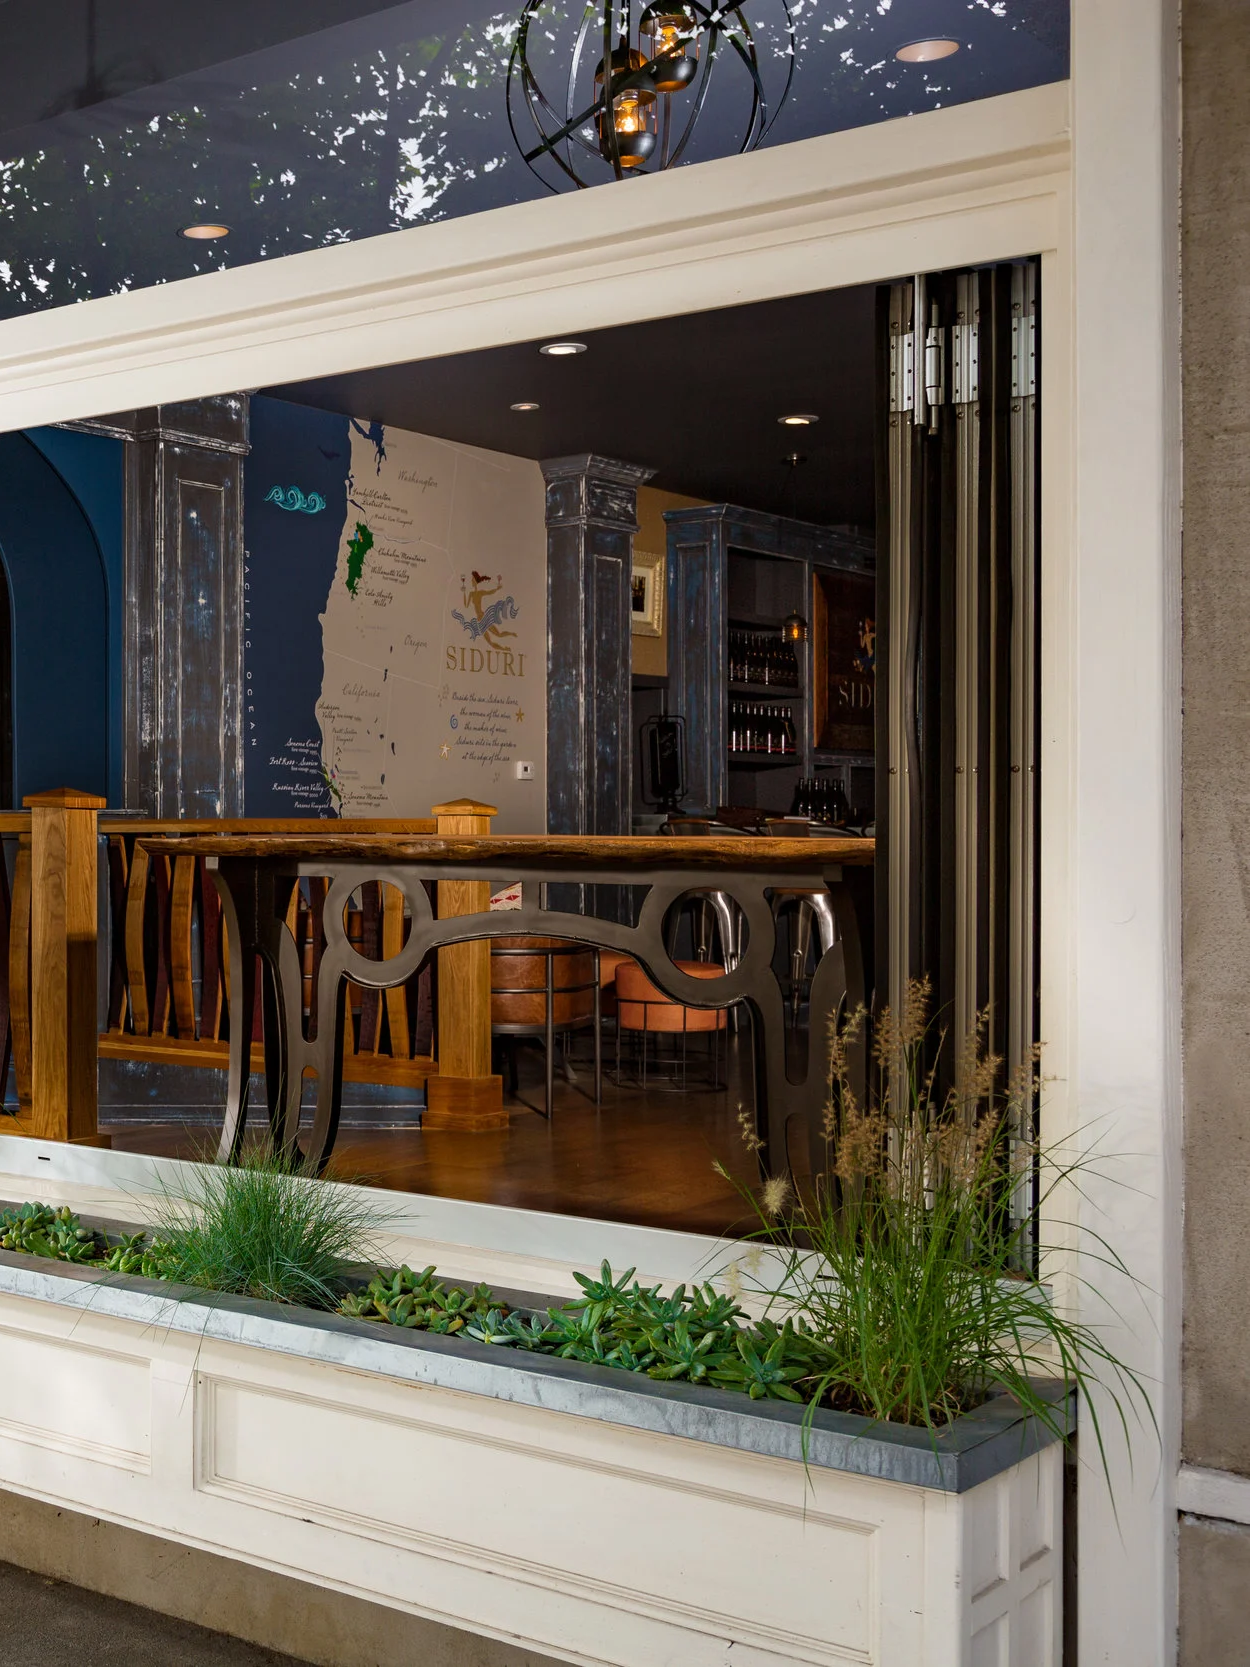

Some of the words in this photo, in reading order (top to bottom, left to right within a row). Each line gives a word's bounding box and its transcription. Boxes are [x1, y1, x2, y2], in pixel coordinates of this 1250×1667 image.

[397, 469, 438, 494] Washington
[401, 551, 427, 563] Mountains
[396, 569, 410, 584] Valley
[244, 550, 252, 648] PACIFIC
[373, 598, 387, 607] Hills
[404, 634, 428, 655] Oregon
[446, 645, 525, 677] SIDURI
[342, 682, 381, 702] California
[469, 693, 477, 702] the
[839, 680, 872, 708] SID
[246, 671, 256, 746] OCEAN
[486, 709, 493, 721] of
[492, 709, 500, 717] the
[322, 711, 335, 723] Valley
[464, 722, 472, 731] the
[489, 724, 495, 735] of
[284, 737, 306, 747] Sonoma
[306, 739, 321, 748] Coast
[455, 736, 474, 746] Siduri
[492, 738, 500, 747] the
[500, 741, 517, 753] garden
[269, 757, 282, 765] Fort
[282, 757, 295, 766] Ross
[298, 757, 318, 766] Seaview
[461, 752, 469, 760] at
[469, 751, 477, 760] the
[477, 753, 488, 767] edge
[488, 752, 494, 765] of
[494, 753, 502, 761] the
[272, 783, 293, 791] Russian
[294, 783, 309, 791] River
[310, 782, 324, 796] Valley
[348, 792, 366, 800] Sonoma
[366, 793, 388, 801] Mountain
[311, 802, 329, 812] Vineyard
